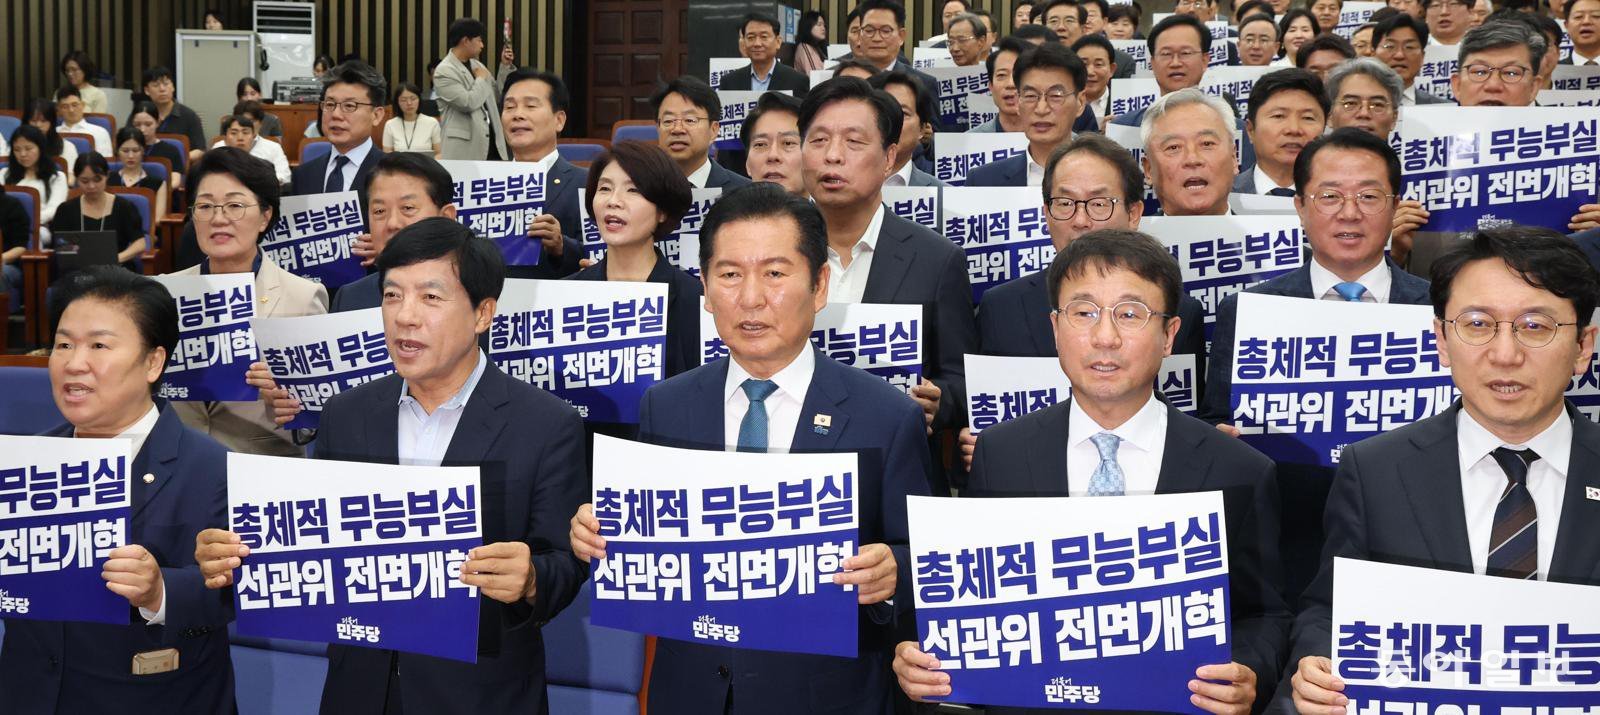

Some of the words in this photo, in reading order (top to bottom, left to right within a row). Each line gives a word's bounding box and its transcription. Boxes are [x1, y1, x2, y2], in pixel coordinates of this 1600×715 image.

[1490, 119, 1597, 162] 무능부실
[471, 172, 543, 205] 무능부실
[1402, 174, 1479, 212] 선관위
[1488, 162, 1596, 205] 전면개혁
[293, 200, 361, 235] 무능부실
[946, 211, 1010, 244] 총체적
[1189, 228, 1300, 277] 무능부실
[173, 285, 254, 328] 능부실
[491, 309, 554, 350] 총체적
[562, 296, 664, 342] 무능부실
[263, 341, 334, 376] 총체적
[337, 331, 390, 367] 무능
[563, 343, 663, 390] 전면개혁
[1236, 335, 1337, 380] 총체적
[1233, 391, 1334, 435] 선관위
[0, 455, 126, 514] 무능부실
[595, 487, 689, 537] 총체적
[701, 472, 853, 536] 무능부실
[232, 498, 330, 550] 총체적
[340, 485, 477, 542] 무능부실
[594, 552, 692, 601] 선관위
[703, 540, 854, 601] 전면개혁
[916, 541, 1038, 604] 총체적
[1051, 512, 1223, 590] 무능부실
[0, 597, 30, 614] 주당
[237, 558, 335, 610] 선관위
[336, 623, 381, 643] 민주당
[692, 621, 741, 643] 민주당
[923, 611, 1043, 670] 선관위
[1055, 587, 1227, 662] 전면개혁
[1337, 621, 1483, 685] 총체적
[1044, 684, 1101, 704] 민주당
